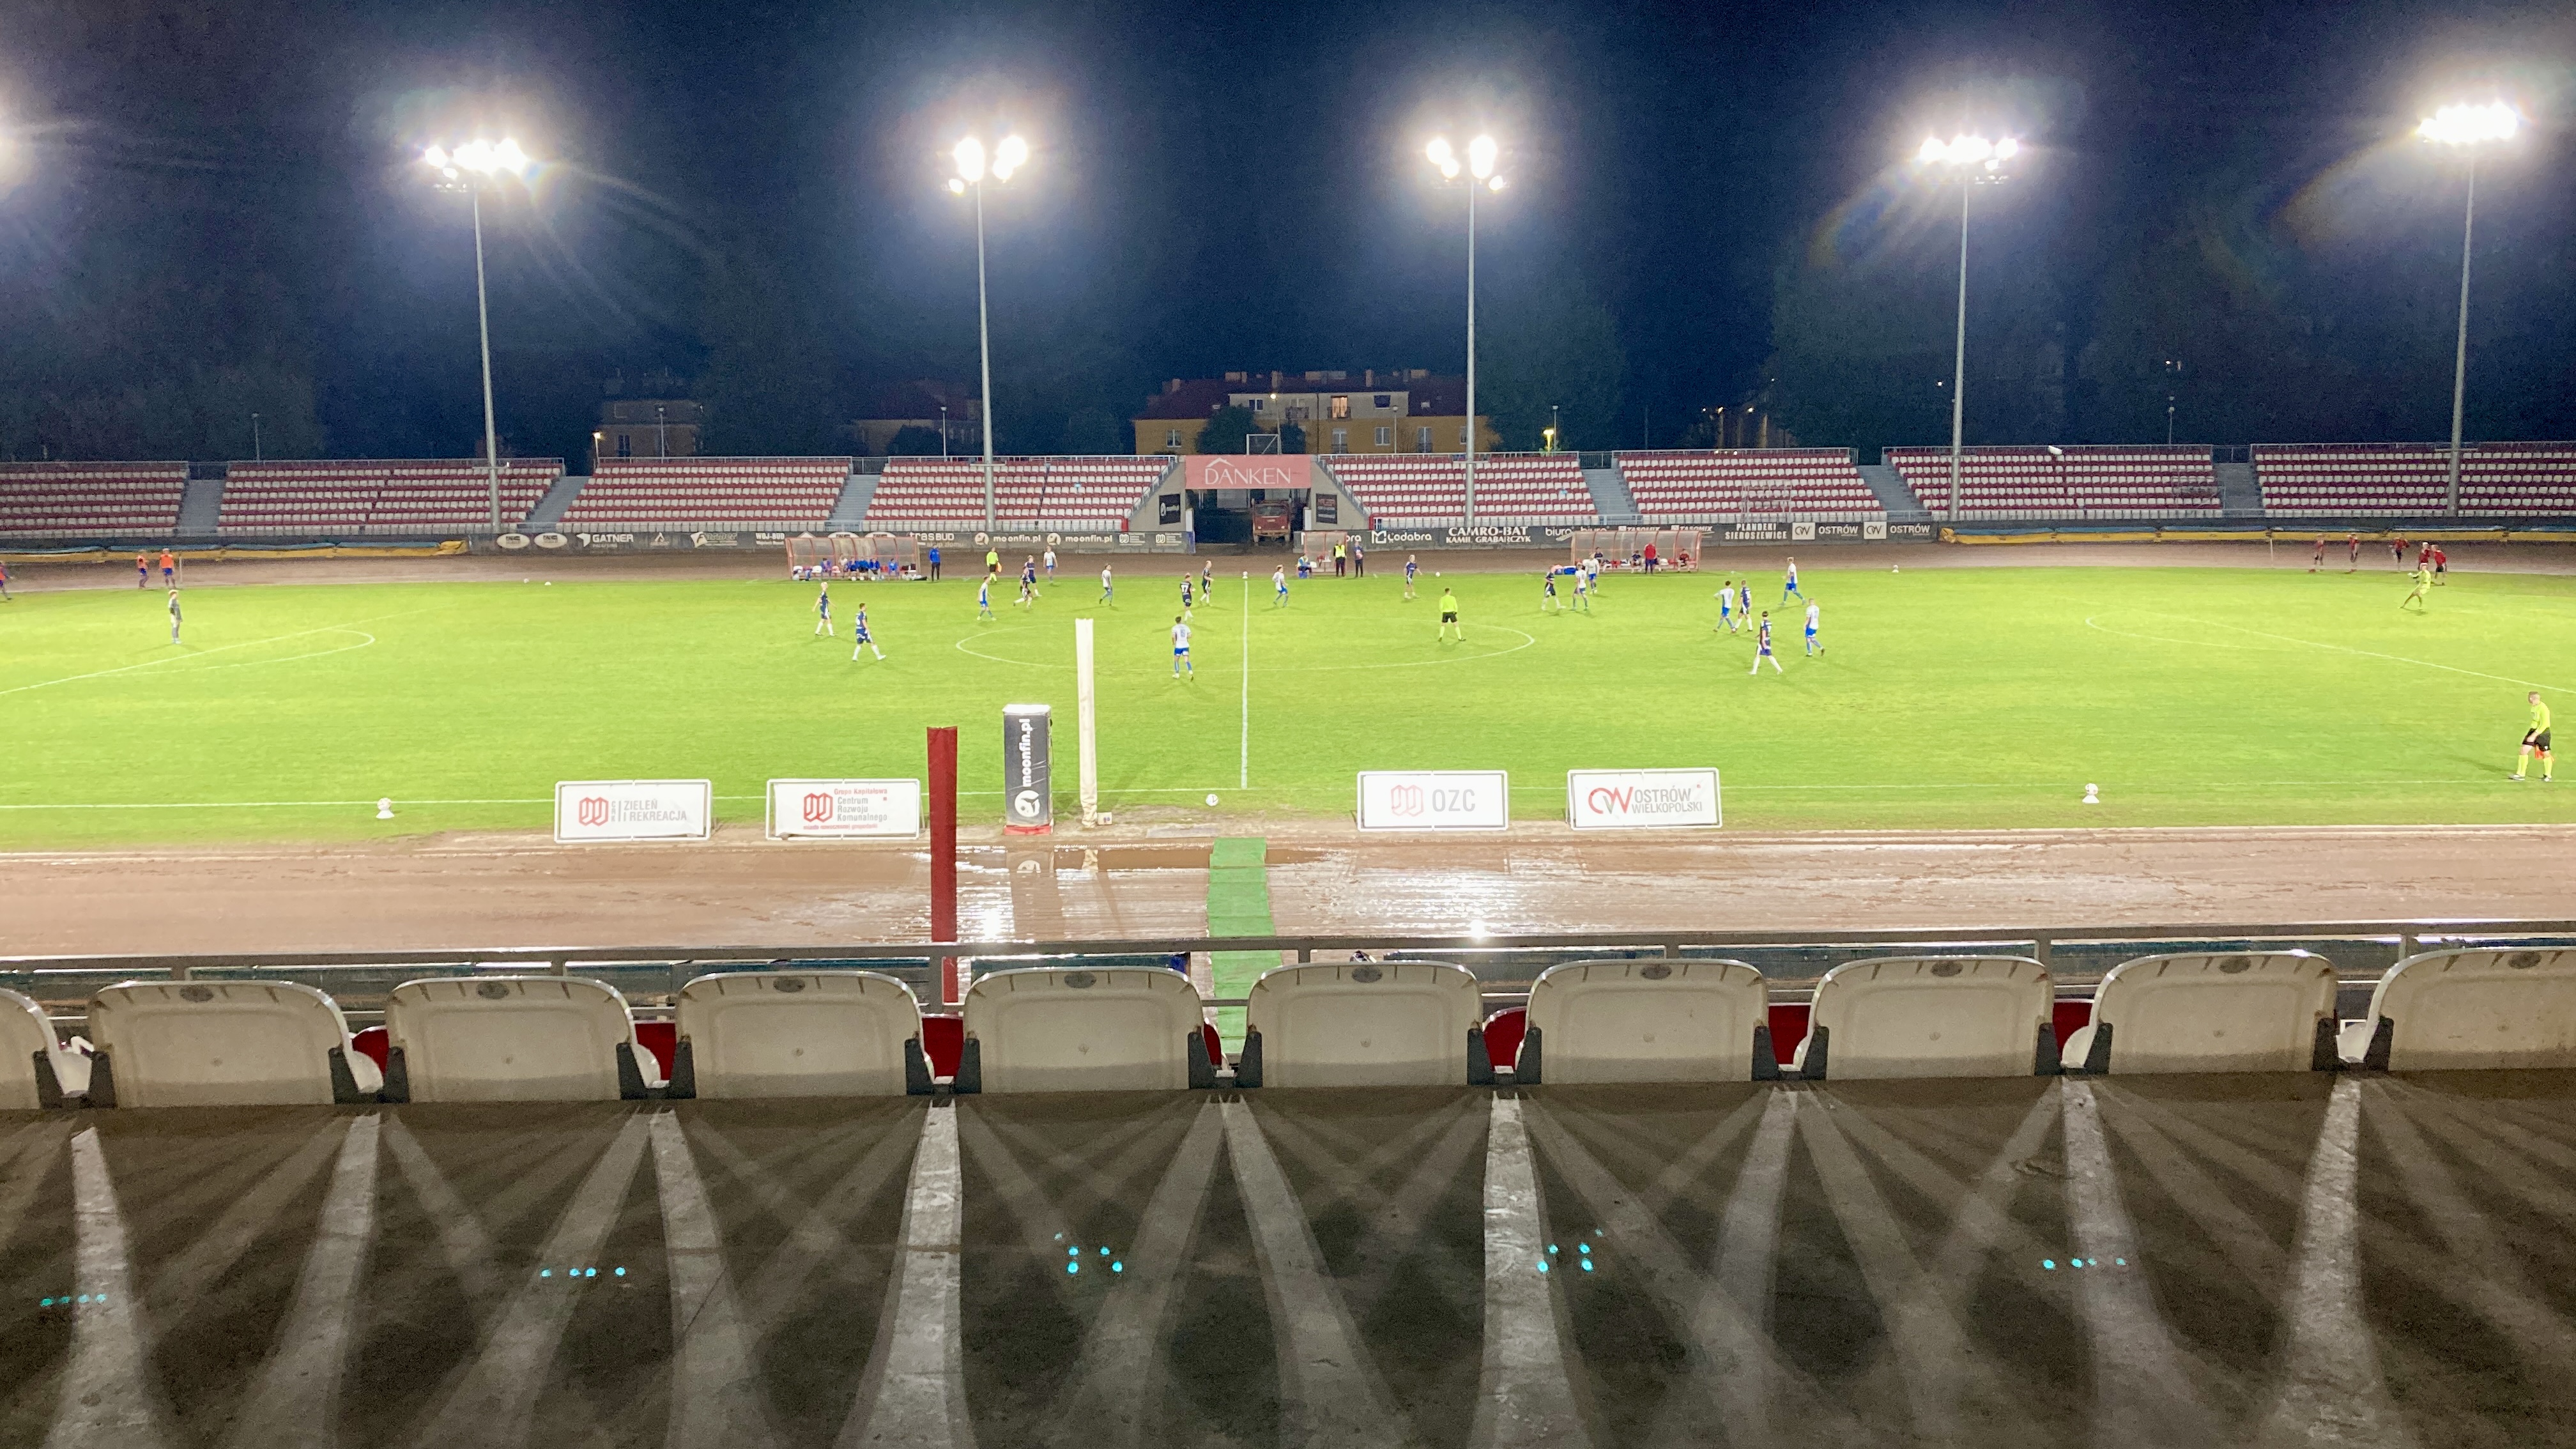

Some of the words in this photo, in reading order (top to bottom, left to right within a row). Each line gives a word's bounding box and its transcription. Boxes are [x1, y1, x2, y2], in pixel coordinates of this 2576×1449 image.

[1204, 467, 1291, 485] DANKEN
[1448, 526, 1529, 537] CAMRO-BAT
[1736, 523, 1776, 531] PLANDEKI
[1818, 524, 1859, 535] OSTRÓW
[1890, 523, 1931, 533] OSTRÓW
[592, 533, 634, 543] GATNER
[993, 534, 1041, 543] moonfin.pl
[1065, 534, 1113, 543] moonfin.pl
[1724, 531, 1788, 540] SIEROSZEWICE
[1018, 718, 1033, 787] moonfin.pl
[1634, 785, 1692, 804] OSTRÓW
[623, 799, 658, 811] ZIELEŃ
[837, 796, 869, 804] Centrum
[1432, 788, 1476, 812] OZC
[837, 804, 869, 814] Rozwoju
[1631, 801, 1703, 814] WIELKOPOLSKI
[629, 811, 687, 822] REKREACJA
[837, 813, 888, 822] Komunalnego
